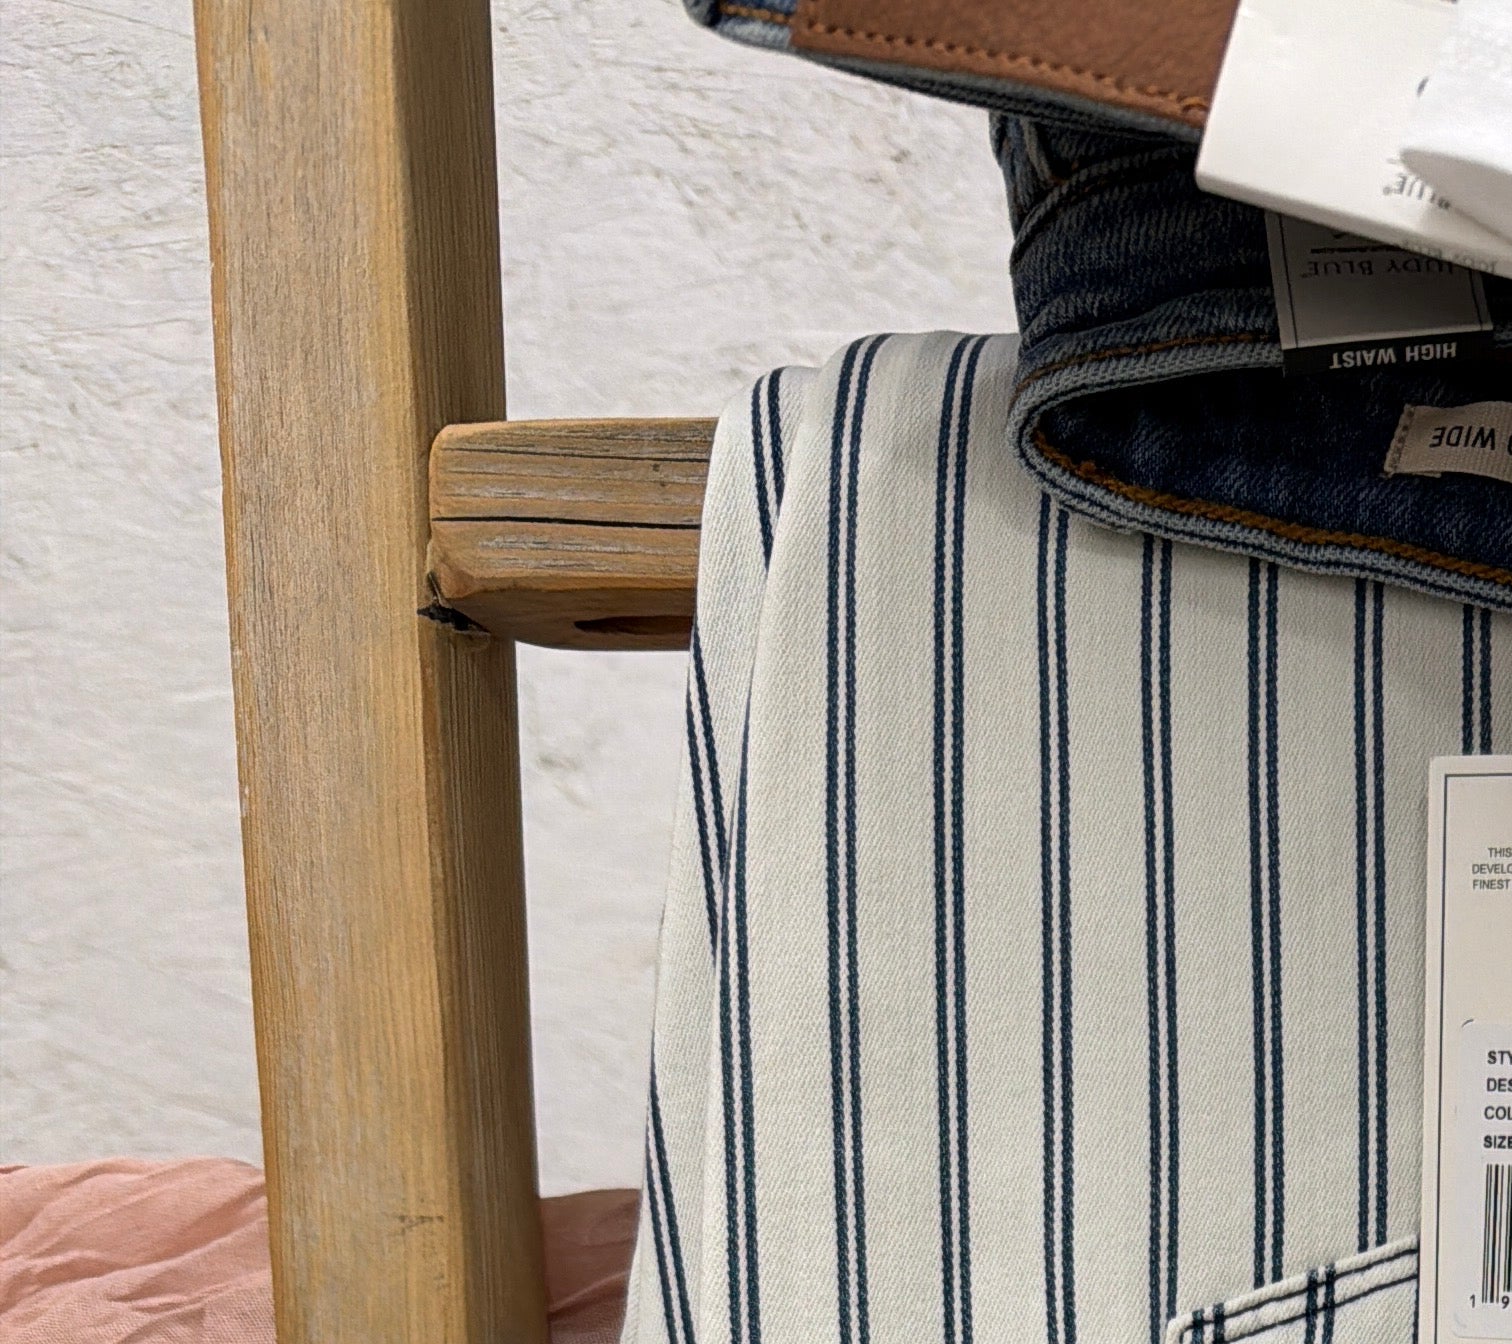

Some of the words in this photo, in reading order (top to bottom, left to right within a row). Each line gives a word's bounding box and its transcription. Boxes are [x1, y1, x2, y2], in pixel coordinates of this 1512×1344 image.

[1329, 348, 1397, 370] WAIST
[1405, 342, 1458, 362] HIGH
[1429, 425, 1496, 451] WIDE
[1487, 847, 1512, 858] THIS
[1472, 879, 1511, 890] FINEST
